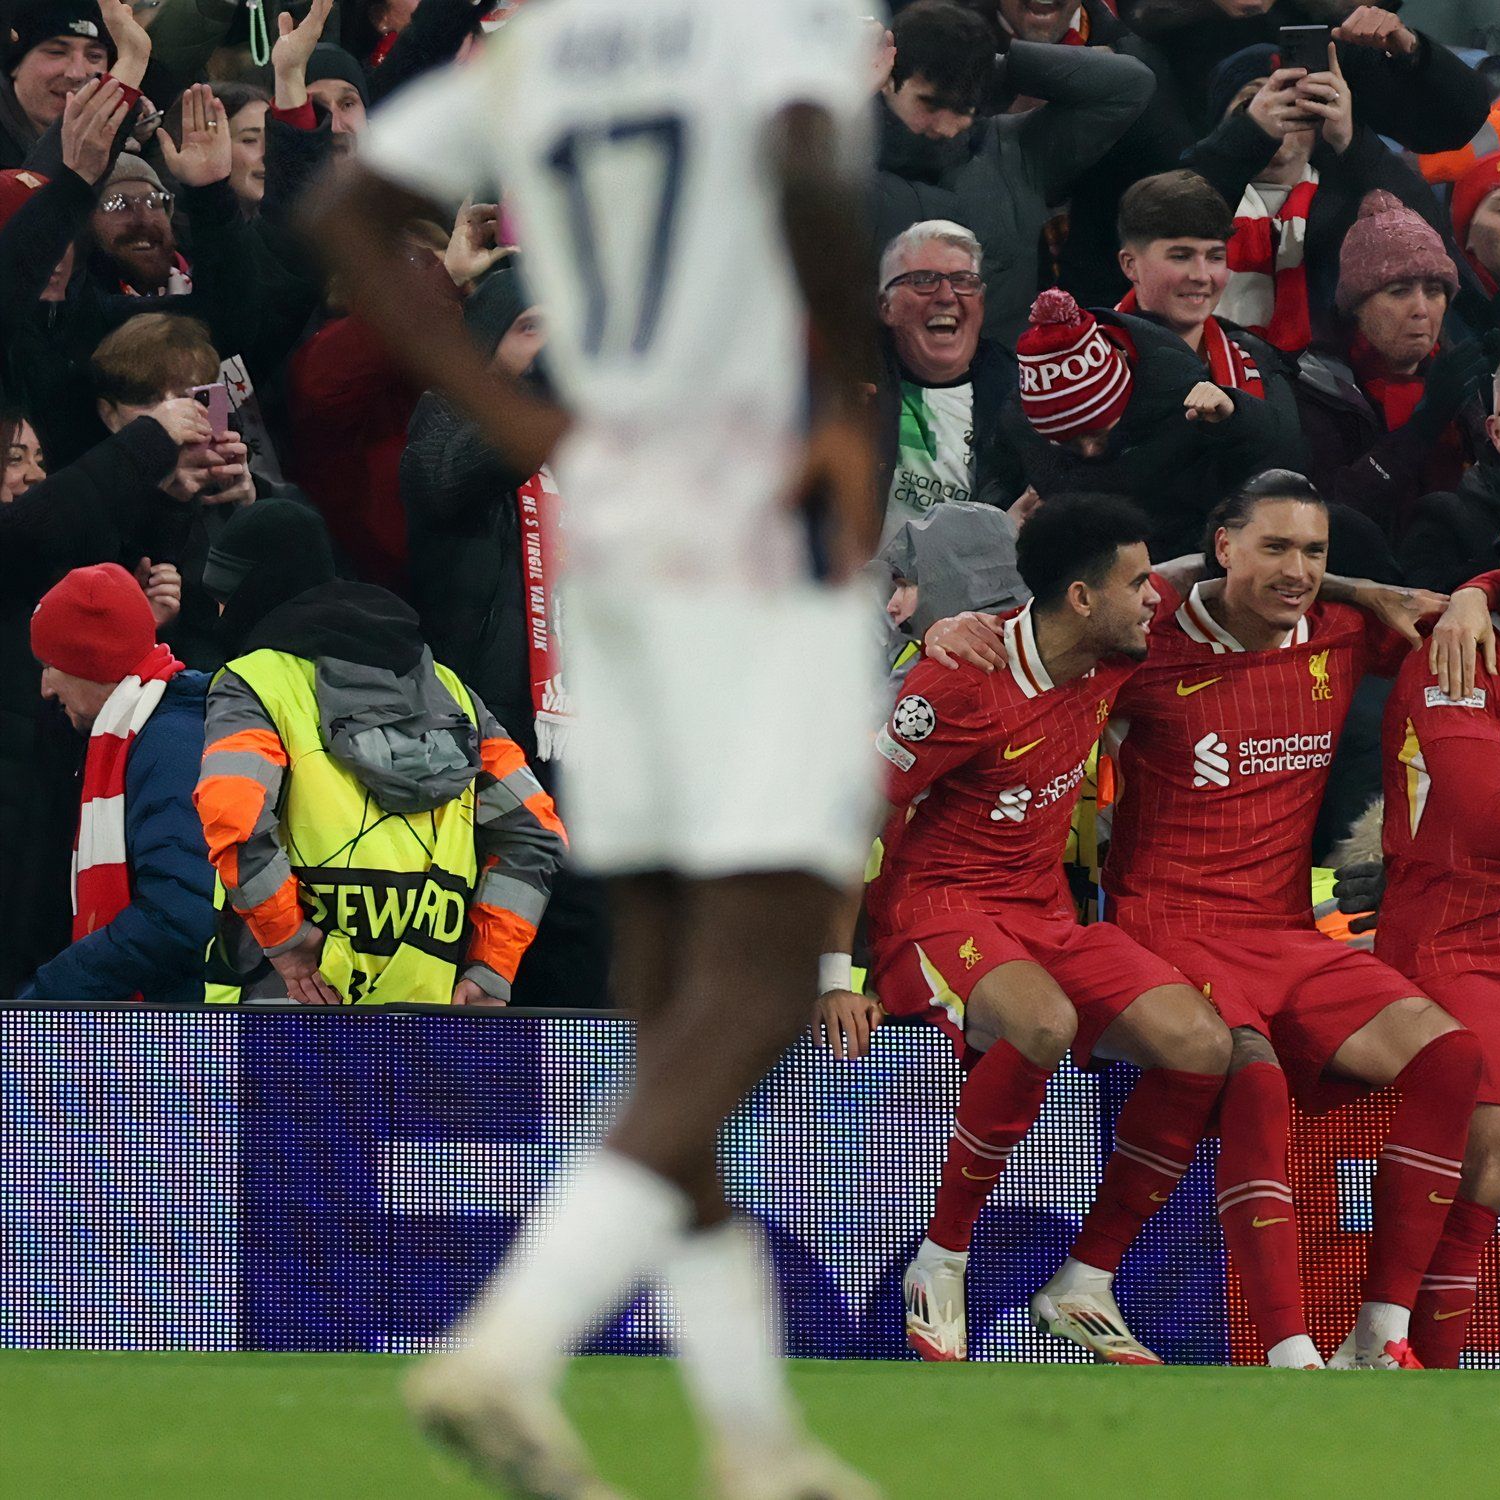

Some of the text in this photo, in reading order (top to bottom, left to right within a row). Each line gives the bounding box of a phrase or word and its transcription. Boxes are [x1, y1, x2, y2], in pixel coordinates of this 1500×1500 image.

[538, 110, 684, 358] 17
[526, 532, 543, 579] VIRGIL
[529, 585, 545, 614] VAN
[531, 617, 548, 652] DIJK
[1238, 731, 1332, 757] standard
